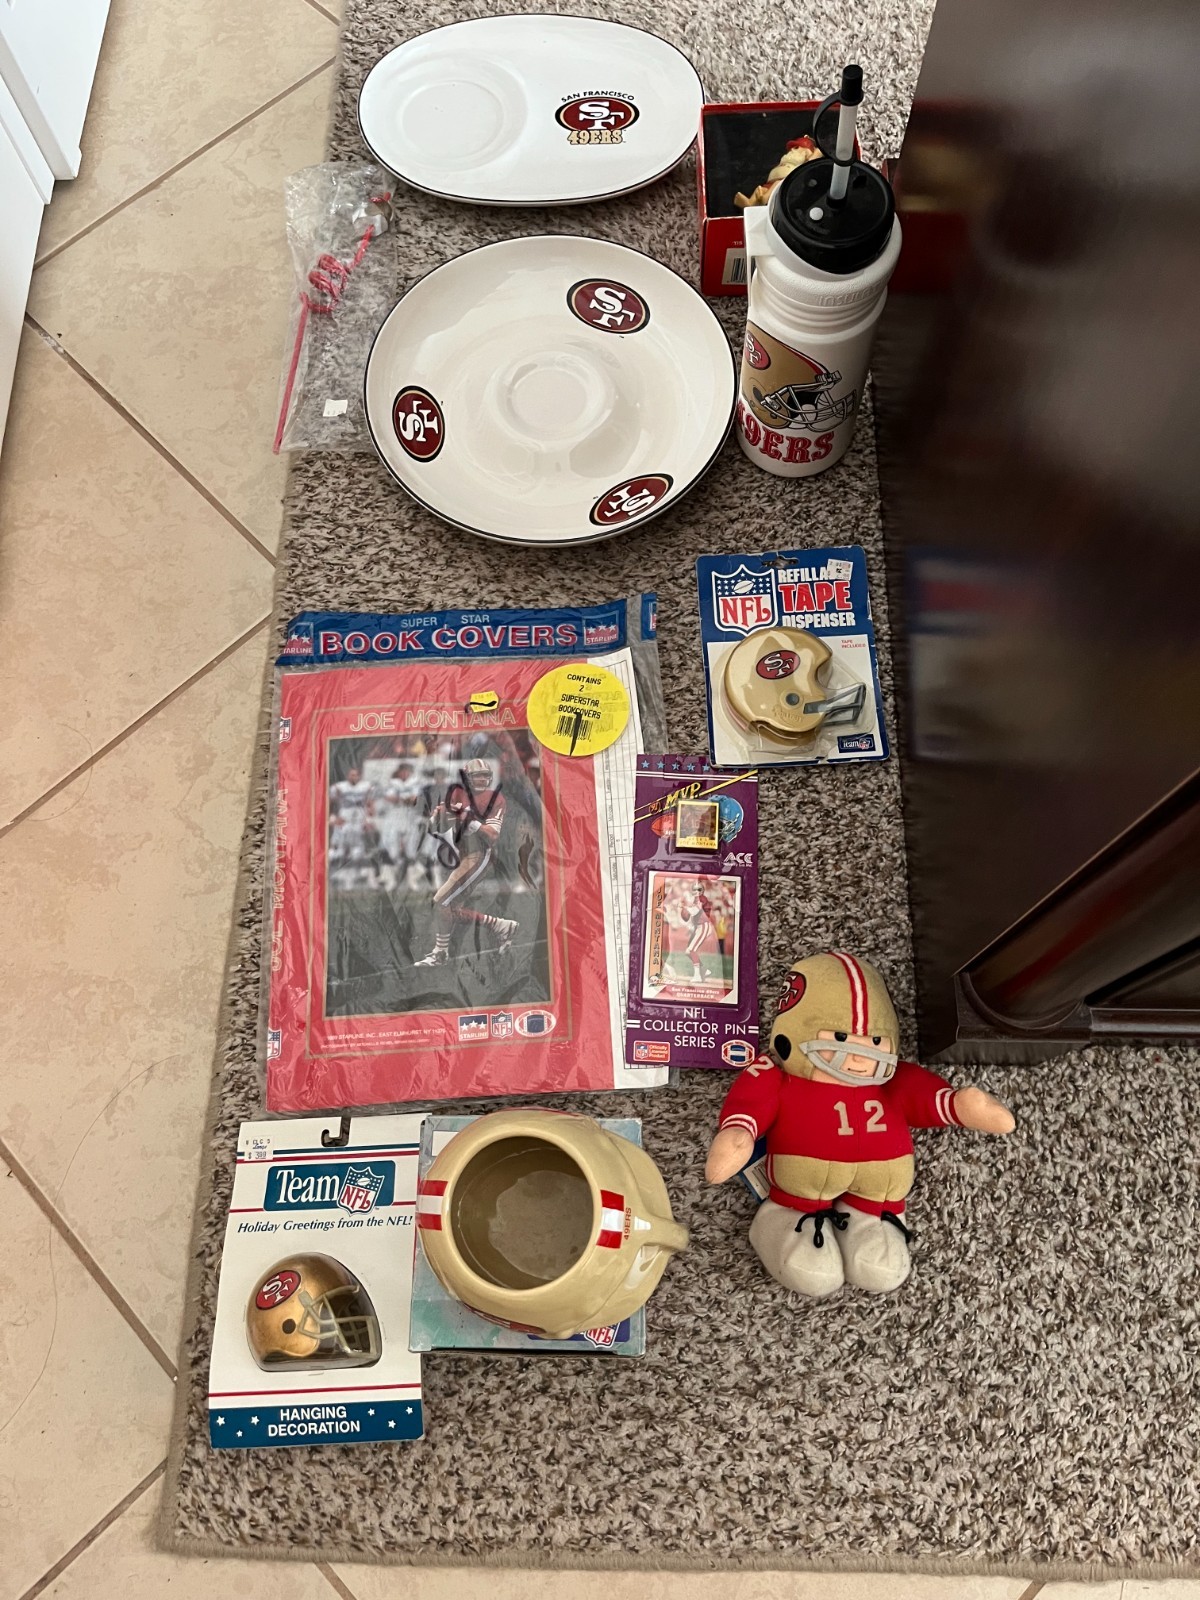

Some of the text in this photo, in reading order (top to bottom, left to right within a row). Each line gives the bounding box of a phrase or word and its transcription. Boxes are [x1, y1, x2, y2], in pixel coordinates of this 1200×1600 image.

[561, 90, 635, 103] SAN FRANCISCO
[579, 101, 624, 130] SF
[567, 129, 623, 145] 49ERS
[588, 286, 635, 328] SF
[777, 566, 837, 583] REFILLA
[778, 580, 853, 613] TAPE
[720, 596, 772, 628] NFL
[401, 614, 490, 628] SUPER STAR
[782, 612, 856, 629] DISPENSER
[319, 623, 578, 655] BOOK COVERS
[283, 646, 313, 655] TARLINE
[566, 673, 602, 685] CONTAINS
[578, 684, 585, 692] 2
[561, 693, 600, 707] SUPERSTAR
[350, 707, 517, 732] JOE MONTANA
[558, 704, 602, 719] BOOKCOVERS
[683, 1008, 707, 1019] NFL
[643, 1020, 746, 1035] COLLECTOR PIN
[674, 1035, 716, 1049] SERIES
[275, 1168, 371, 1212] Team NFL
[237, 1215, 413, 1234] Holiday Greetings from the NFL!
[623, 1207, 632, 1241] 49ERS
[280, 1406, 347, 1421] HANGING
[267, 1420, 361, 1437] DECORATION
